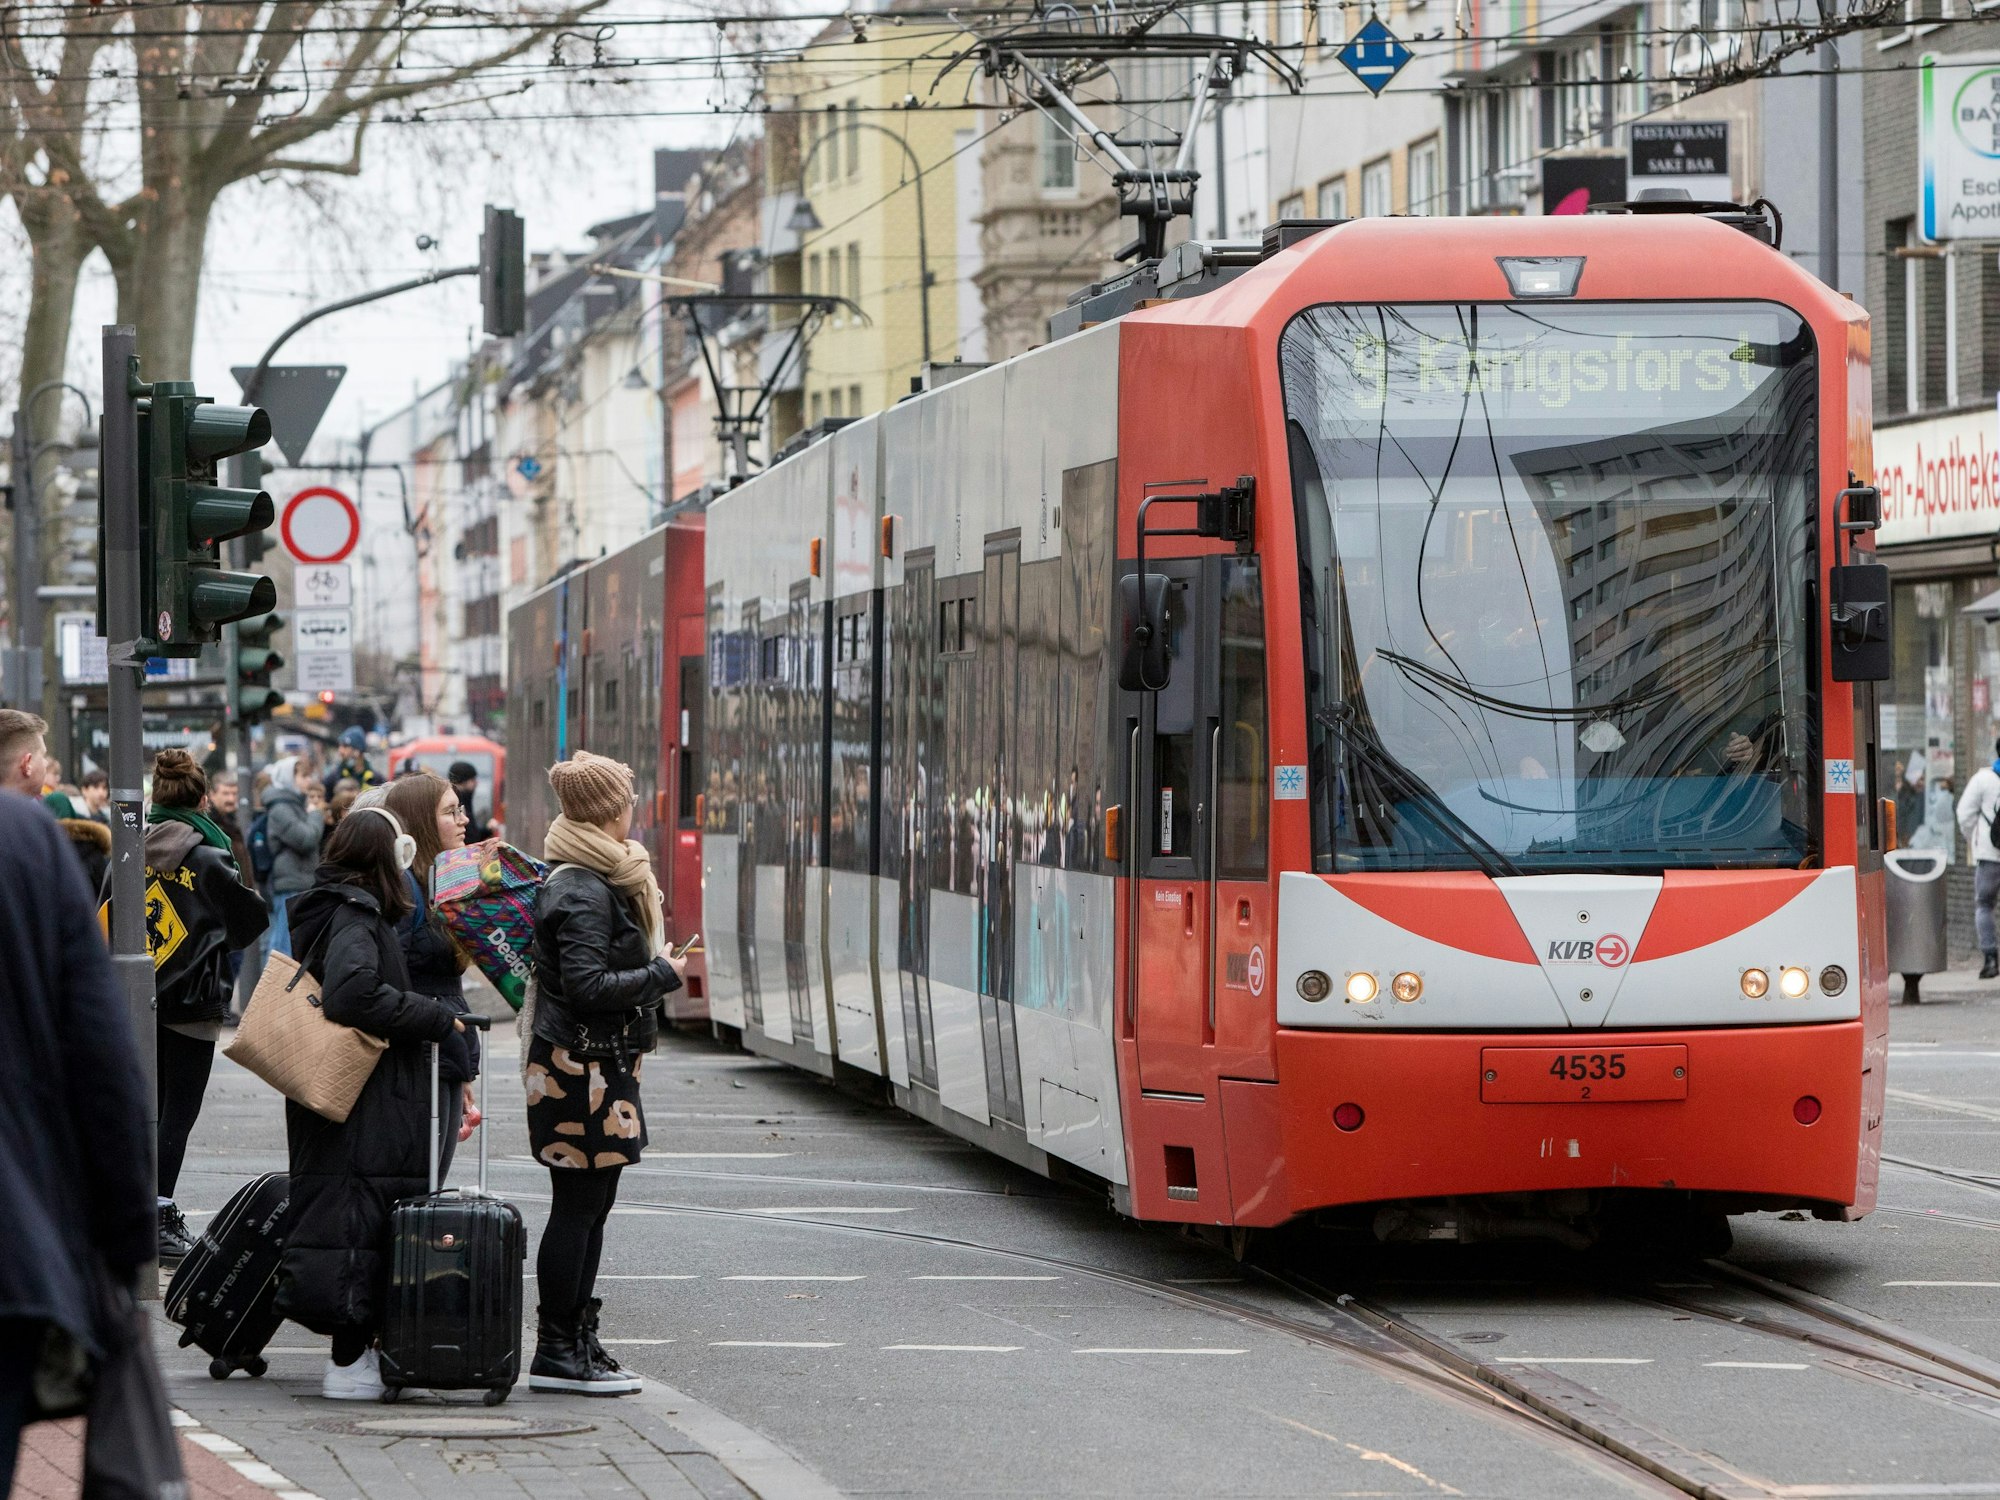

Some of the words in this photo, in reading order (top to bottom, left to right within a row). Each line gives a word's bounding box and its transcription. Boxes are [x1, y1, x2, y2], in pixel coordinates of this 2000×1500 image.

[1633, 125, 1723, 140] RESTAURANT
[1648, 158, 1682, 173] SAKE
[1685, 158, 1715, 173] BAR
[1354, 332, 1387, 409] 9
[1419, 330, 1756, 408] Königsforst
[1155, 890, 1165, 902] Kein
[1165, 890, 1182, 906] Einstieg
[1548, 941, 1594, 960] KVB
[1550, 1053, 1626, 1081] 4535
[1581, 1086, 1591, 1100] 2
[209, 1250, 254, 1309] TRAVELLER
